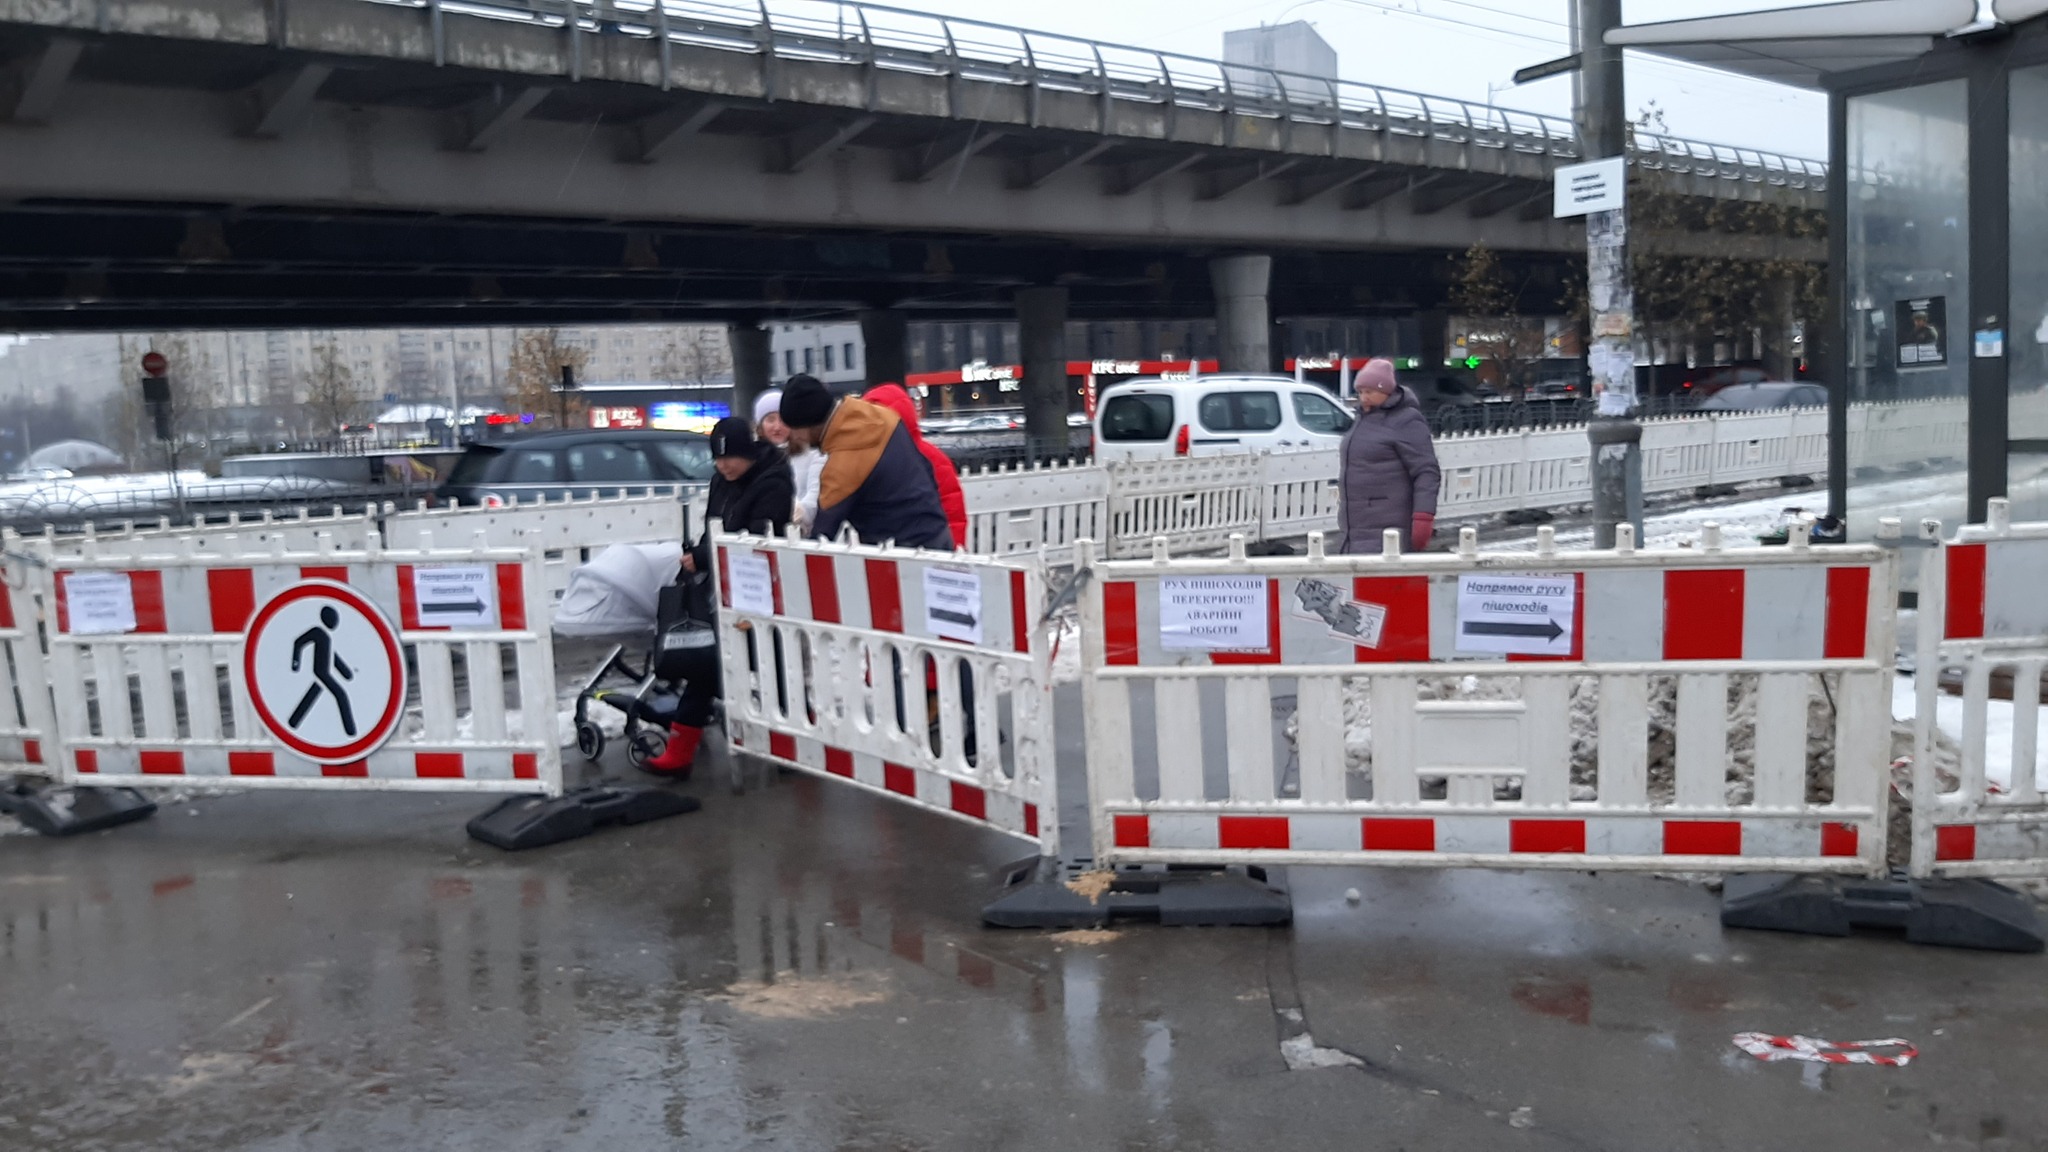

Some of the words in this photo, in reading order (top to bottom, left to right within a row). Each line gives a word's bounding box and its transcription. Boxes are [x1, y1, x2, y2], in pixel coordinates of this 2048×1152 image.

[1164, 580, 1187, 590] РУХ
[1190, 580, 1263, 590] ПІШОХОДІВ
[1466, 581, 1534, 595] Напрямок
[1536, 584, 1566, 596] руху
[1172, 595, 1255, 605] ПЕРЕКРИТО!!!
[1482, 600, 1549, 613] пішоходів
[1185, 609, 1242, 621] АВАРІЙНІ
[1190, 625, 1238, 635] РОБОТИ
